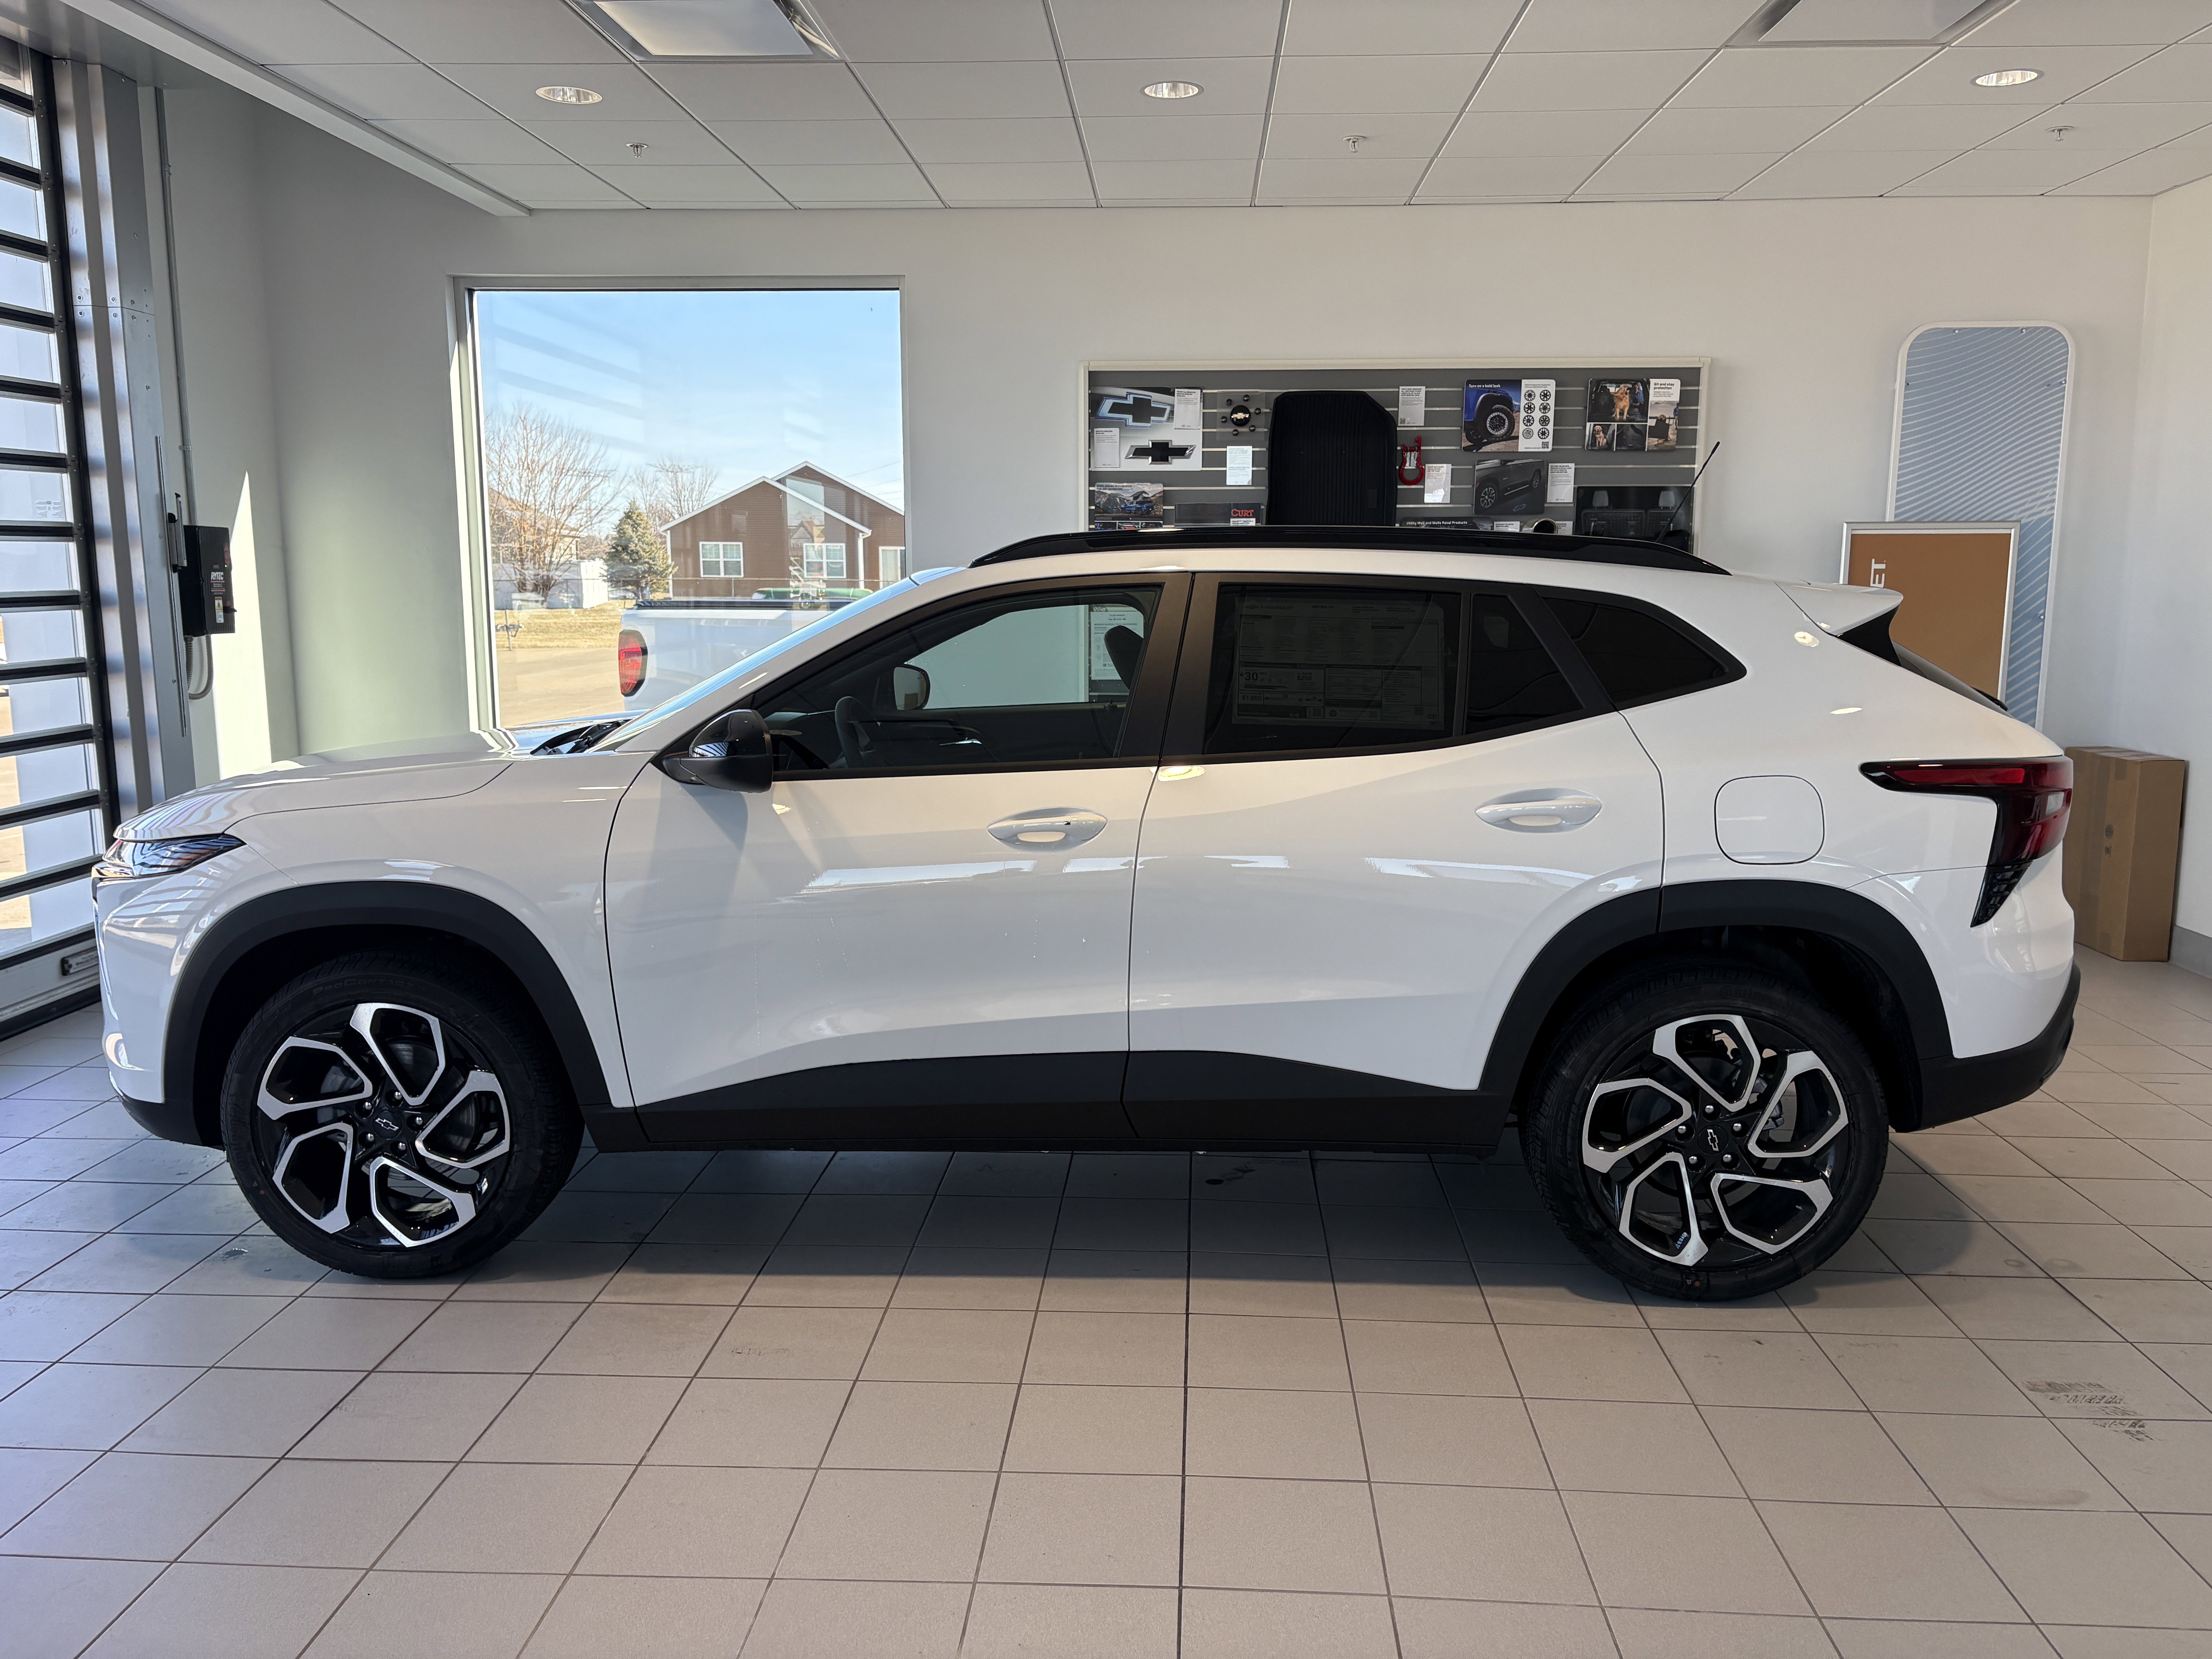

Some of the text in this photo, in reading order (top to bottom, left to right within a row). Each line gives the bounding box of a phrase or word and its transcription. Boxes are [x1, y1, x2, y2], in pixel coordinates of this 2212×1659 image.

[1231, 509, 1254, 517] CURT
[211, 572, 224, 580] RYTEC
[1244, 672, 1259, 681] 30
